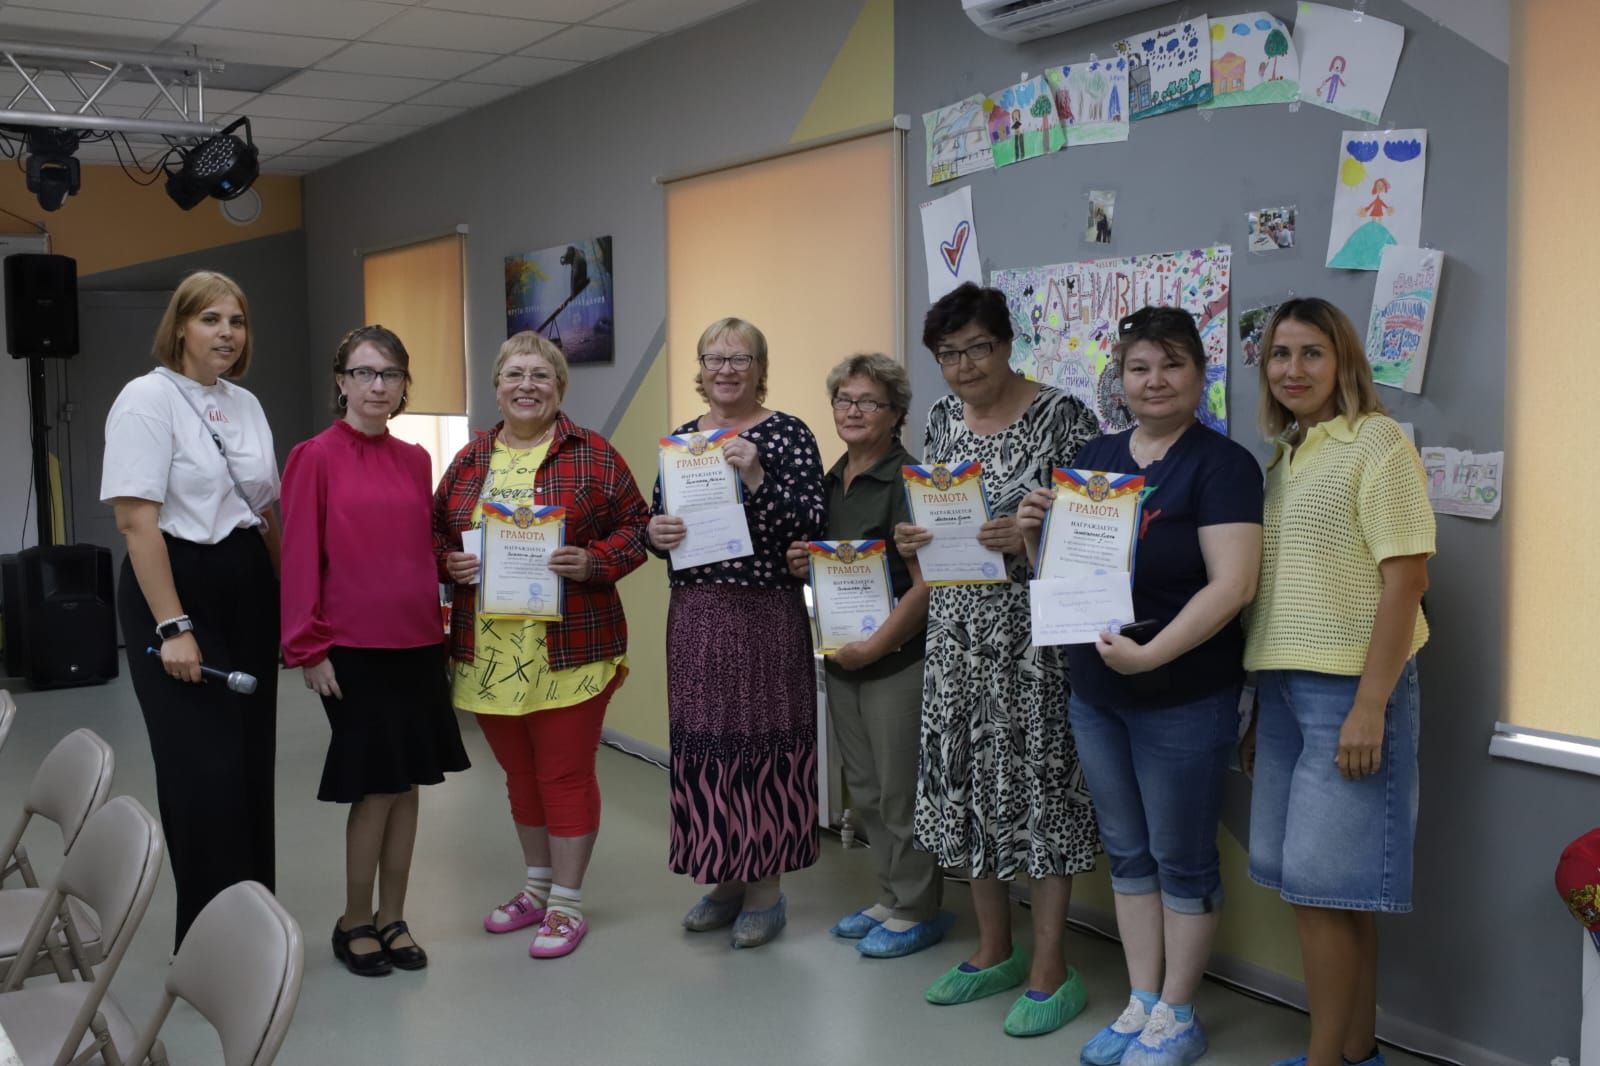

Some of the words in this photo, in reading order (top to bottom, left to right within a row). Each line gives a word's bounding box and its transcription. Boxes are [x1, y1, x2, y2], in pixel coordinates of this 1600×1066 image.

[676, 456, 721, 469] ГРАМОТА
[922, 492, 969, 504] ГРАМОТА
[1068, 501, 1120, 518] ГРАМОТА
[500, 529, 545, 541] ГРАМОТА
[826, 565, 872, 575] ГРАМОТА
